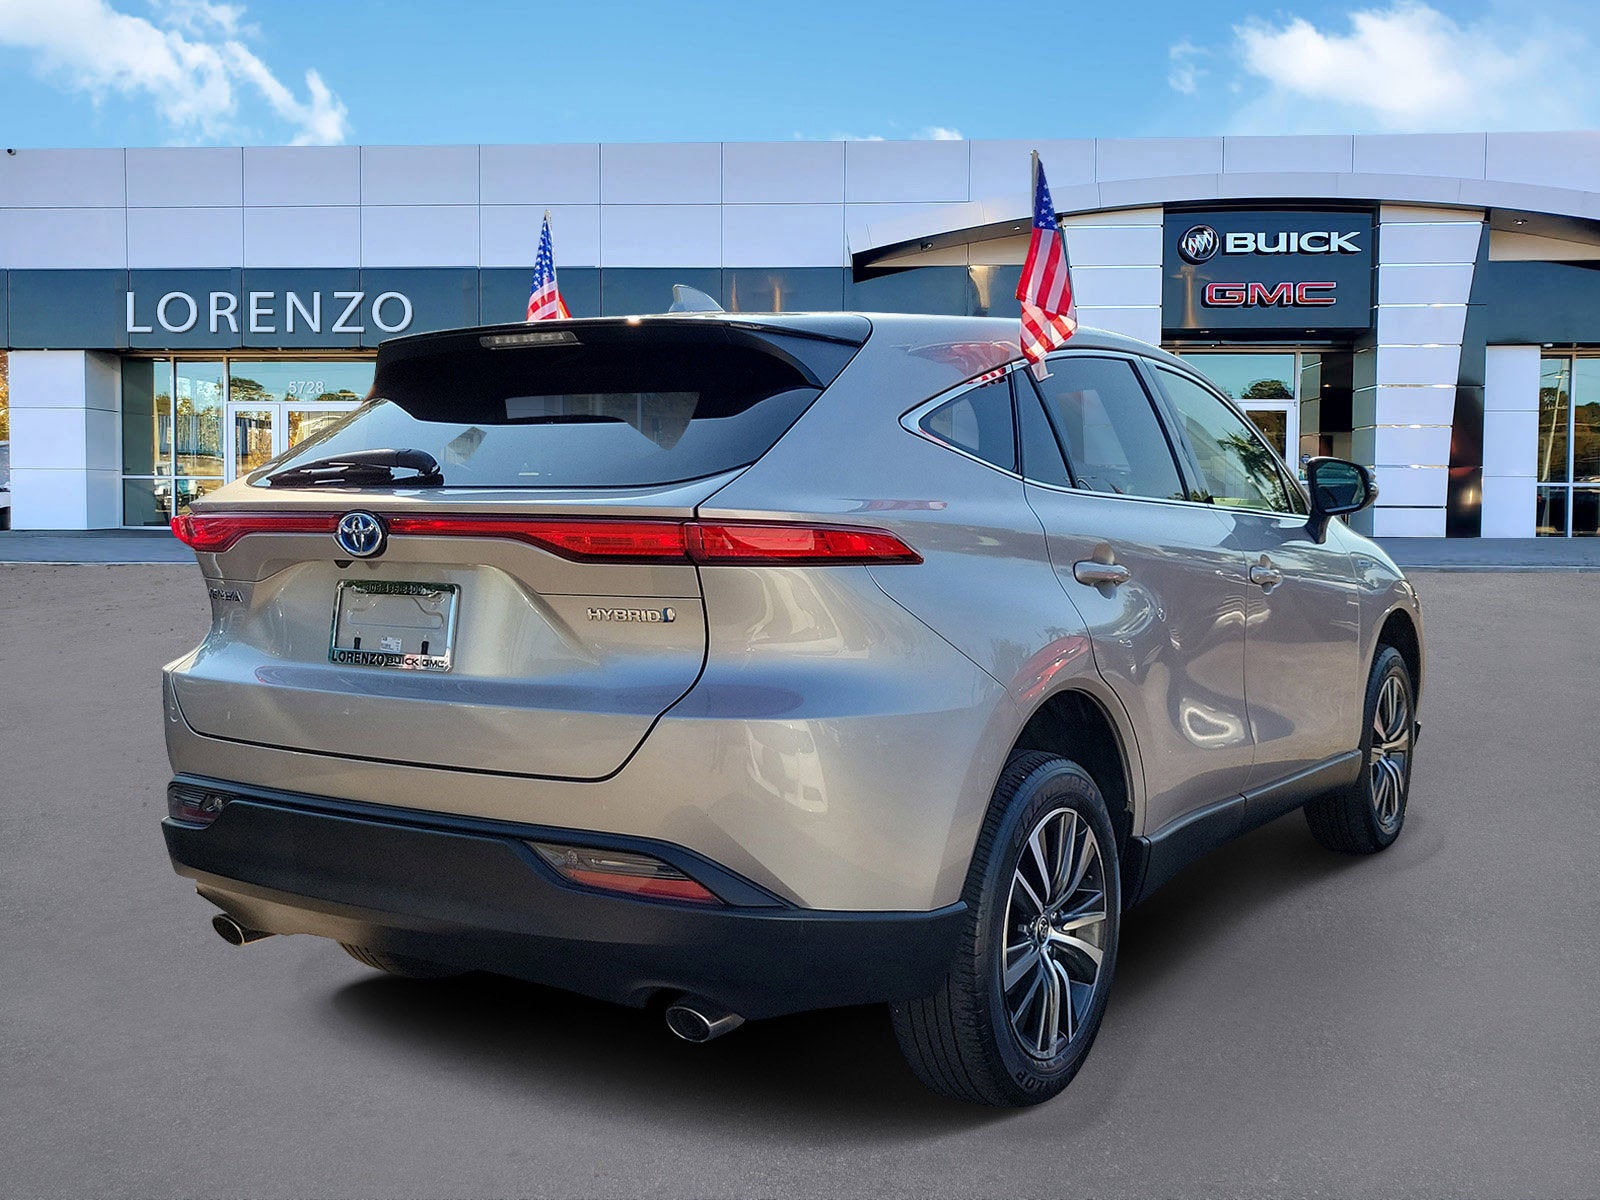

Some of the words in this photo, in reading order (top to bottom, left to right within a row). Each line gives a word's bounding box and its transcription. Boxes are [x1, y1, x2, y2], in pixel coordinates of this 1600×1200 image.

[1225, 231, 1362, 253] BUICK
[1205, 281, 1337, 306] GMC
[126, 291, 413, 334] LORENZO
[288, 381, 325, 395] 5728
[587, 607, 662, 622] HYBRID
[331, 651, 385, 666] LORENZO
[386, 656, 420, 668] BUICK
[421, 657, 446, 669] GMC
